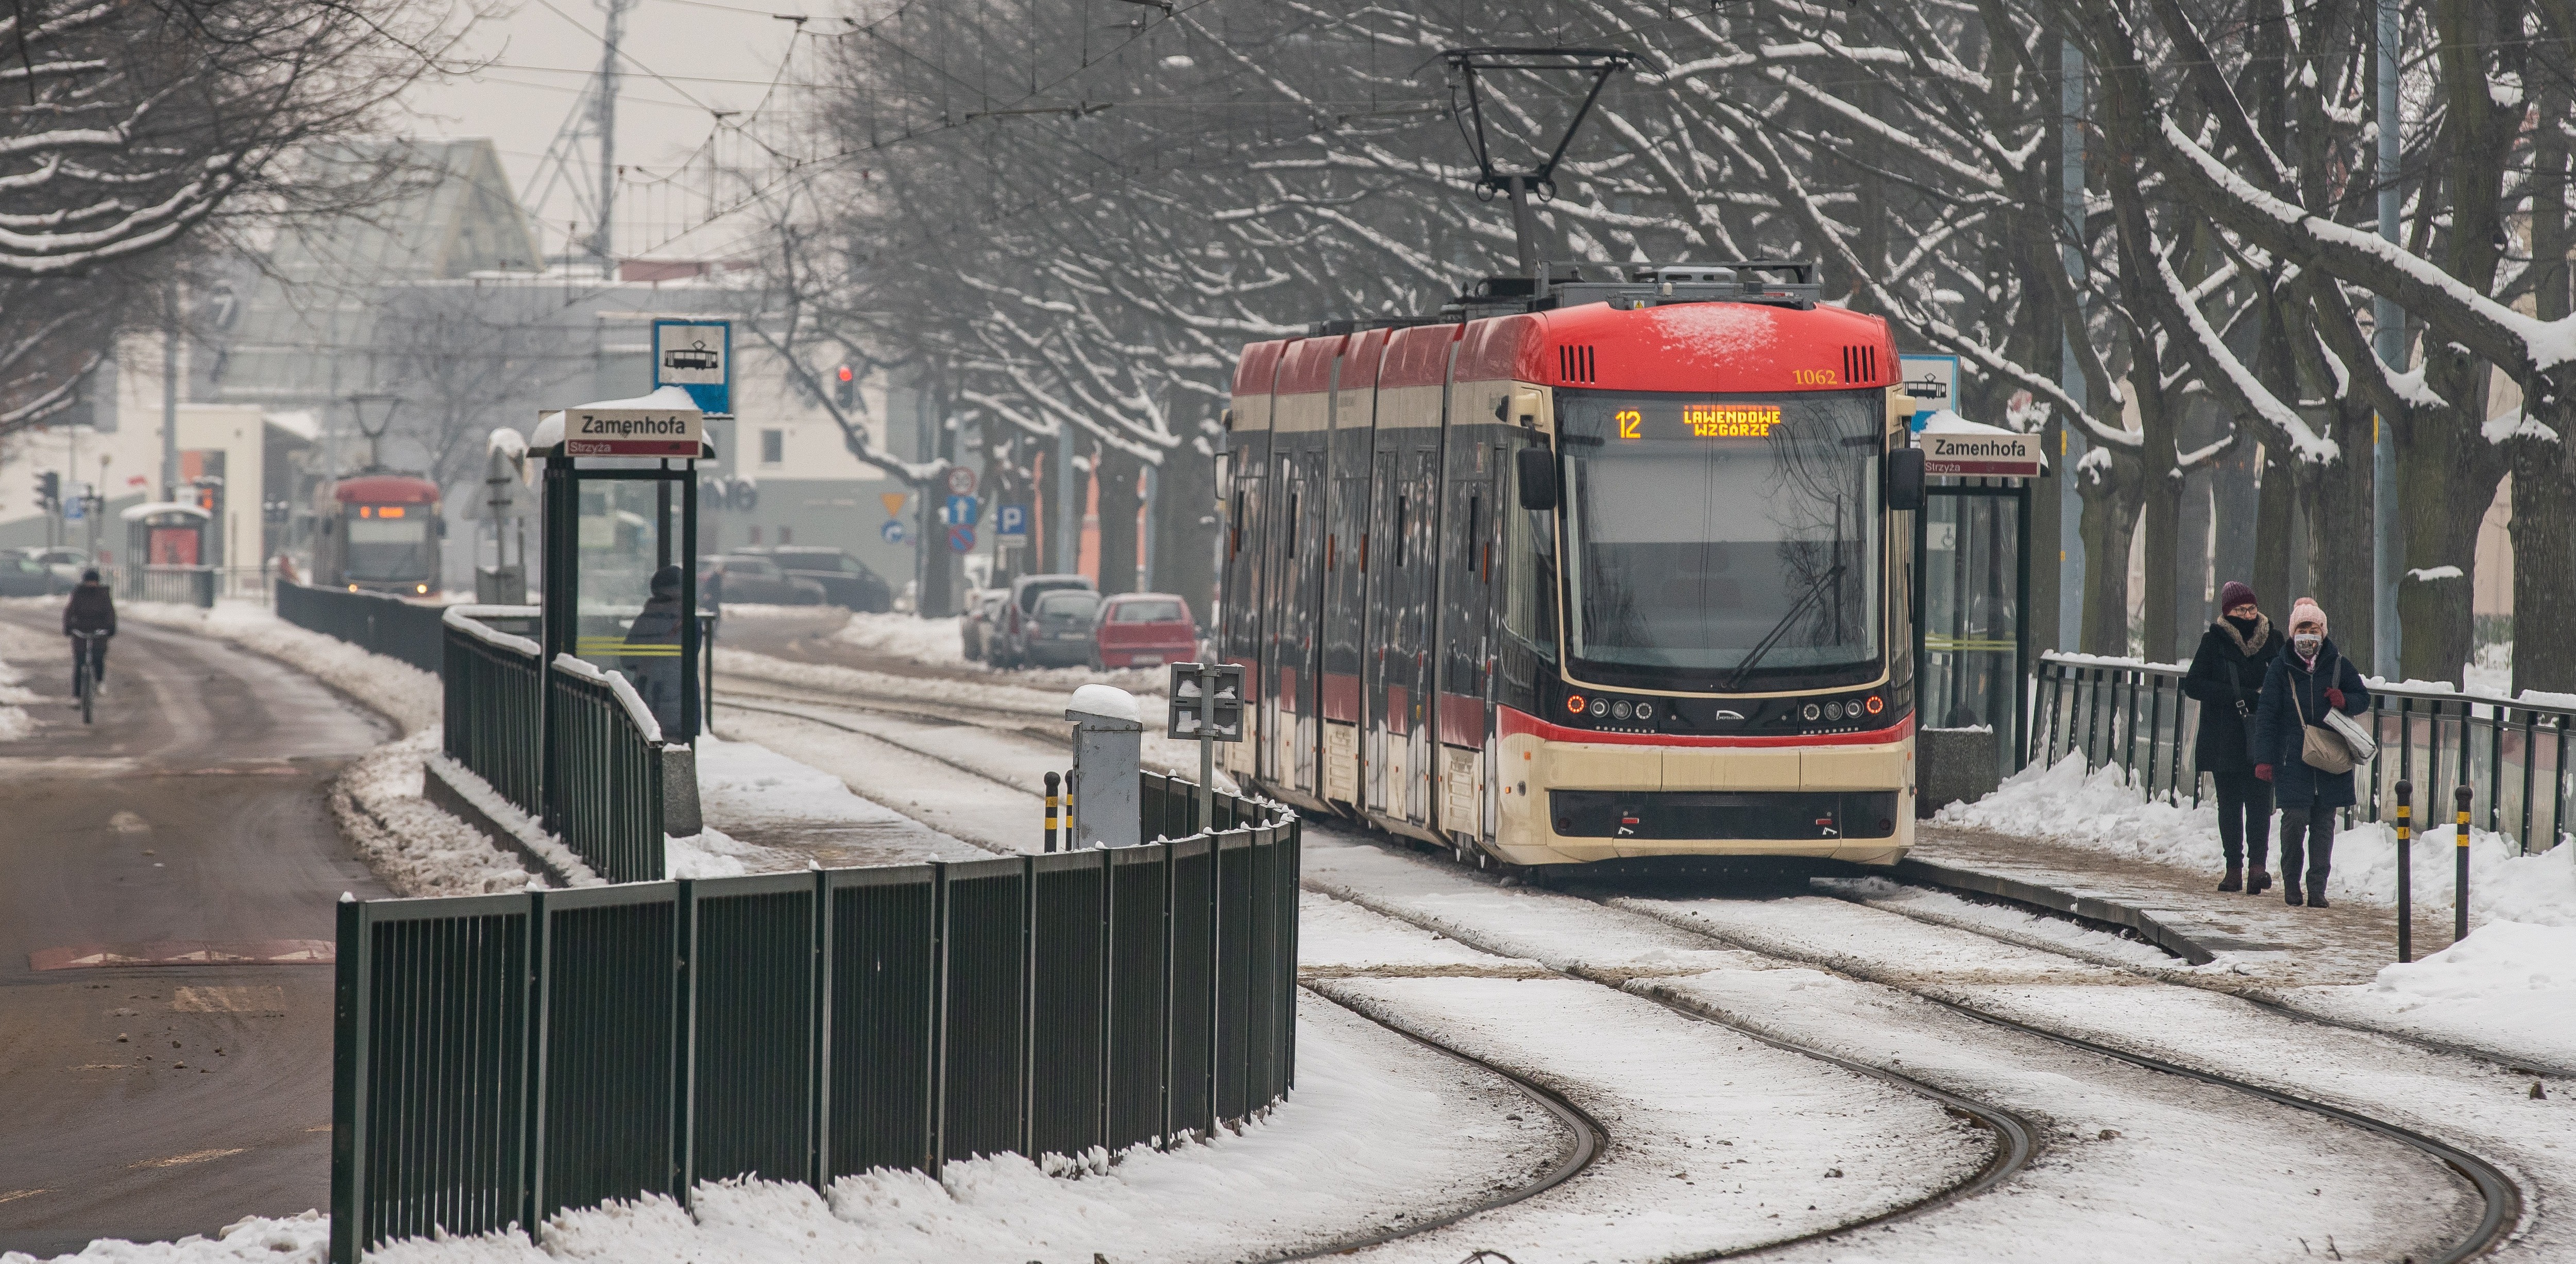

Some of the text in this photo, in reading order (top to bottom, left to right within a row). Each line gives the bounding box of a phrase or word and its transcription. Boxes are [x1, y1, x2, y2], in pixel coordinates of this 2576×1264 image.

[1792, 369, 1838, 385] 1062
[581, 415, 686, 435] Zamenhofa
[1615, 411, 1641, 438] 12
[1683, 411, 1781, 424] LAWENDOWE
[1935, 438, 2026, 457] Zamenhofa
[1003, 507, 1022, 532] P
